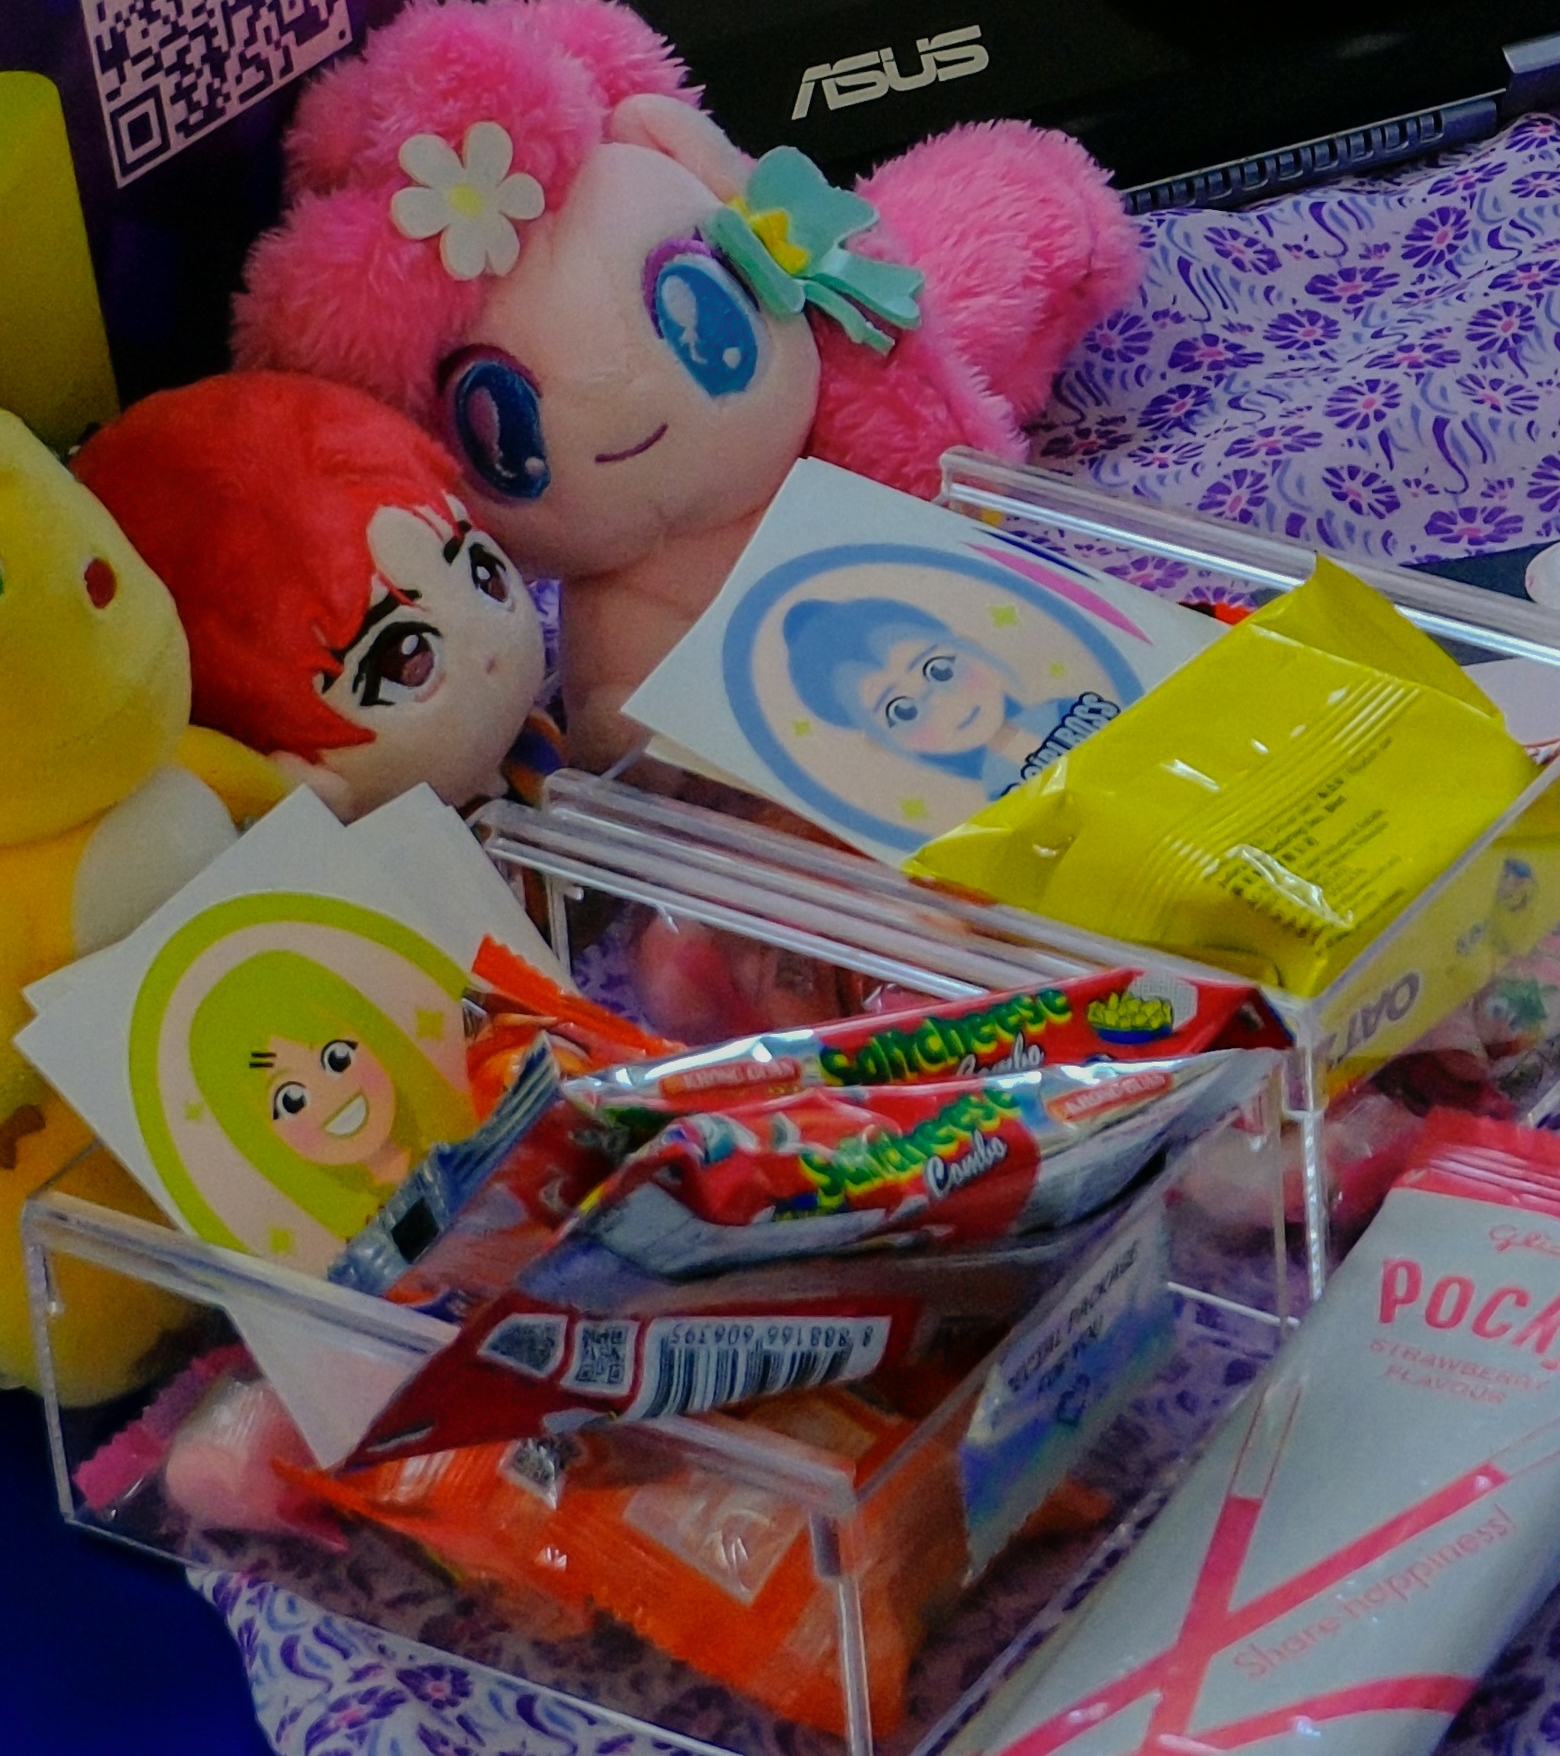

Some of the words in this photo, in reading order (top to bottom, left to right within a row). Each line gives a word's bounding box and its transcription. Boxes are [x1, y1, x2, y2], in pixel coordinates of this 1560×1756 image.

[791, 24, 990, 121] ASUS
[922, 1131, 1010, 1201] Combo
[1369, 1338, 1551, 1391] STRAWBERRY
[1232, 1616, 1339, 1678] Share
